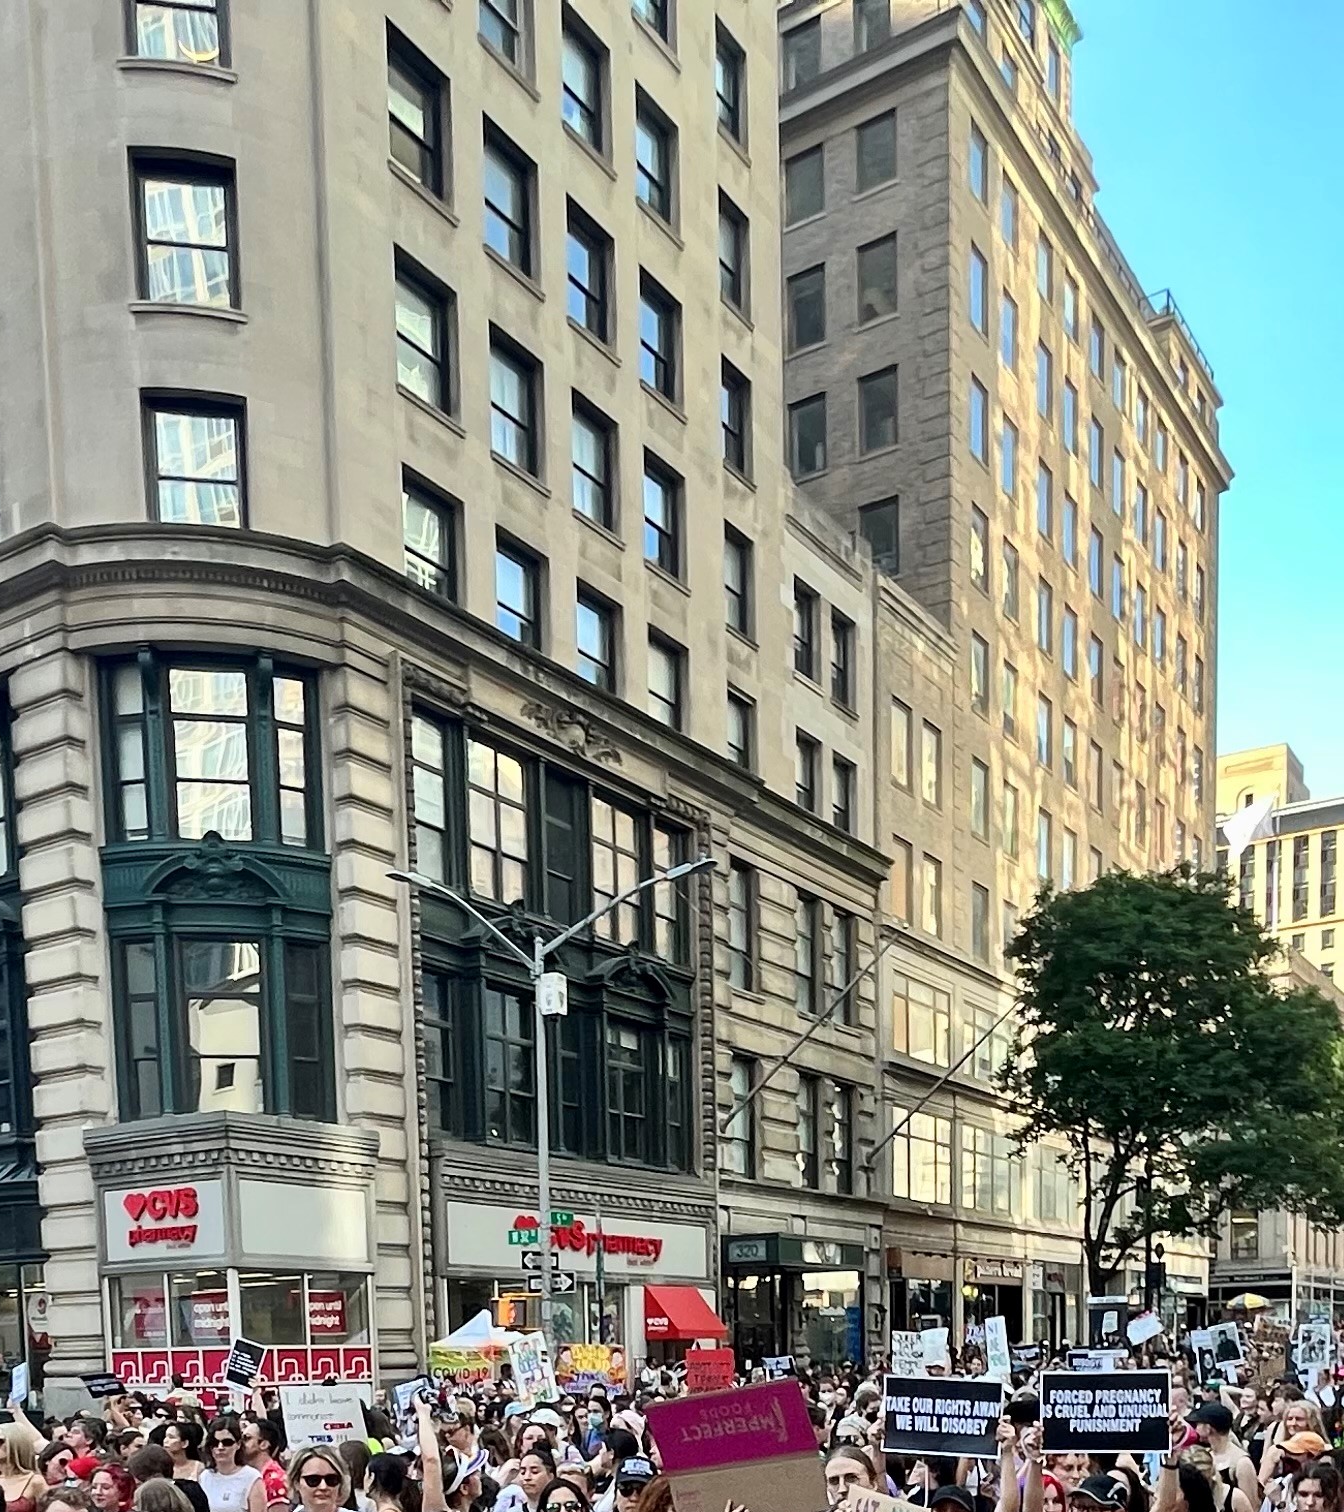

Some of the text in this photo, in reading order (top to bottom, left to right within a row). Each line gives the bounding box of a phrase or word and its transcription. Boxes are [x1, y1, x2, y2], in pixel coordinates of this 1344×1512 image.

[146, 1187, 199, 1221] CVS
[128, 1225, 198, 1248] pharmacy
[736, 1242, 759, 1259] 320
[308, 1301, 325, 1312] pen
[1049, 1388, 1162, 1405] FORCED PREGNANCY
[886, 1396, 1002, 1419] TAKE OUR RIGHTS AWAY
[1041, 1402, 1170, 1419] IS CRUEL AND UNUSUAL
[896, 1414, 989, 1436] WE WILL DISOBEY
[1069, 1419, 1142, 1433] PUNISHMENT
